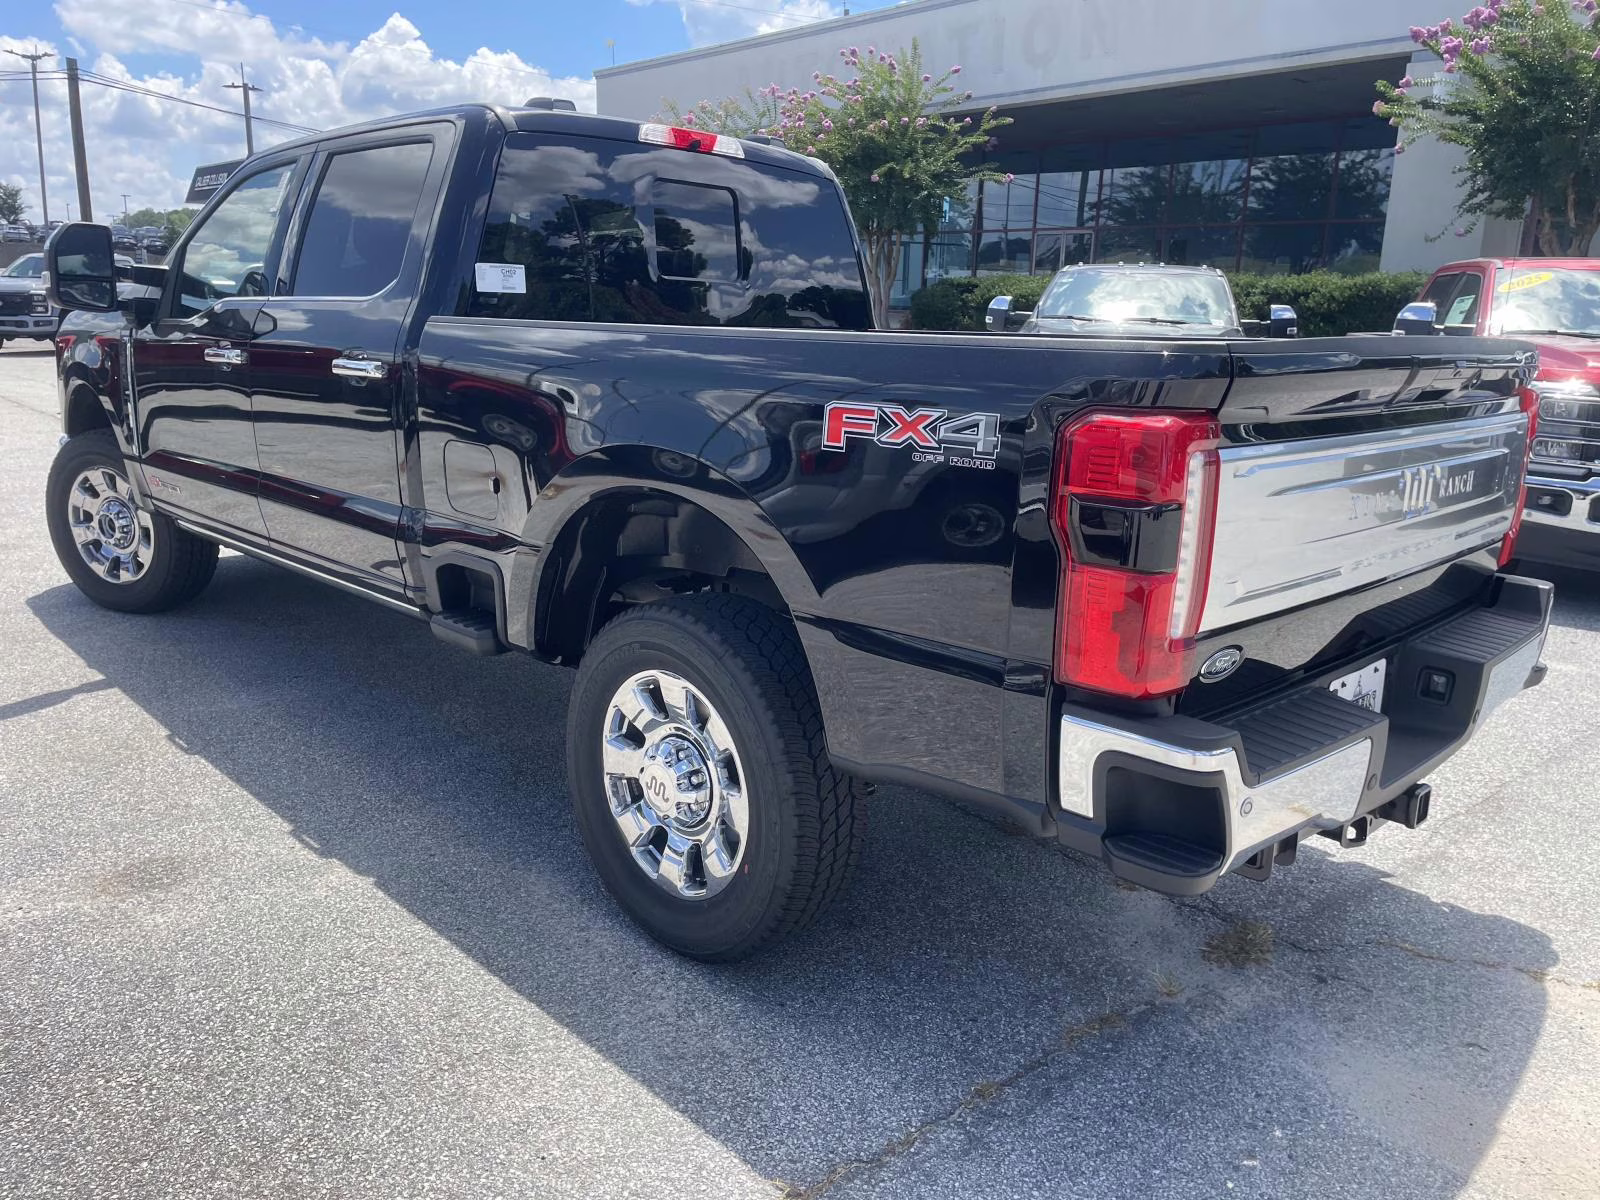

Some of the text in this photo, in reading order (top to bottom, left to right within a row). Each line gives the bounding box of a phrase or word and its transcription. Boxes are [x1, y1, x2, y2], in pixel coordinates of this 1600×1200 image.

[821, 400, 1001, 460] FX4
[911, 452, 996, 470] OFF ROAD
[1439, 470, 1475, 497] RANCH
